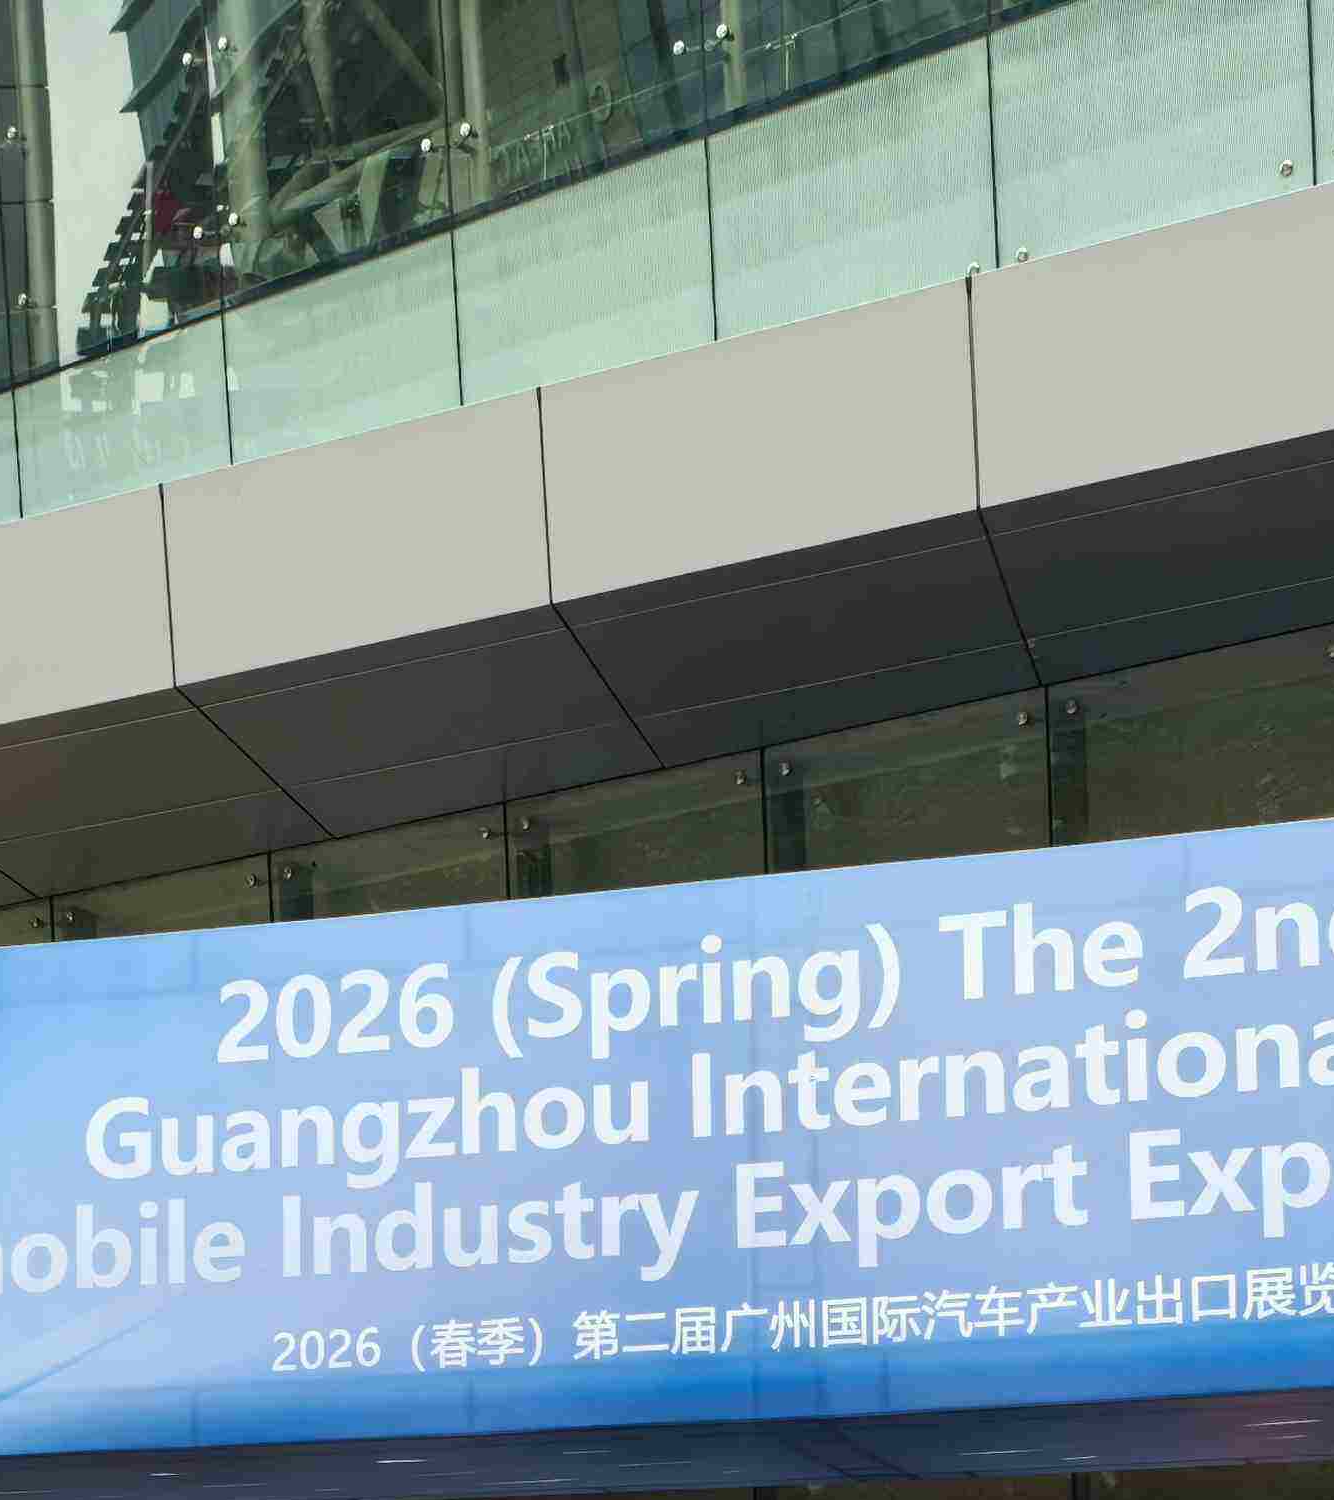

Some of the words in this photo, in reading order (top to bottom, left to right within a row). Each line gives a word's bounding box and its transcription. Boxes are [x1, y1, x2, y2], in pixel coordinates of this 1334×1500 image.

[215, 962, 456, 1064] 2026
[491, 923, 901, 1060] (Spring)
[938, 902, 1145, 1002] The
[85, 1066, 650, 1191] Guangzhou
[281, 1180, 700, 1283] Industry
[733, 1144, 1089, 1268] Export
